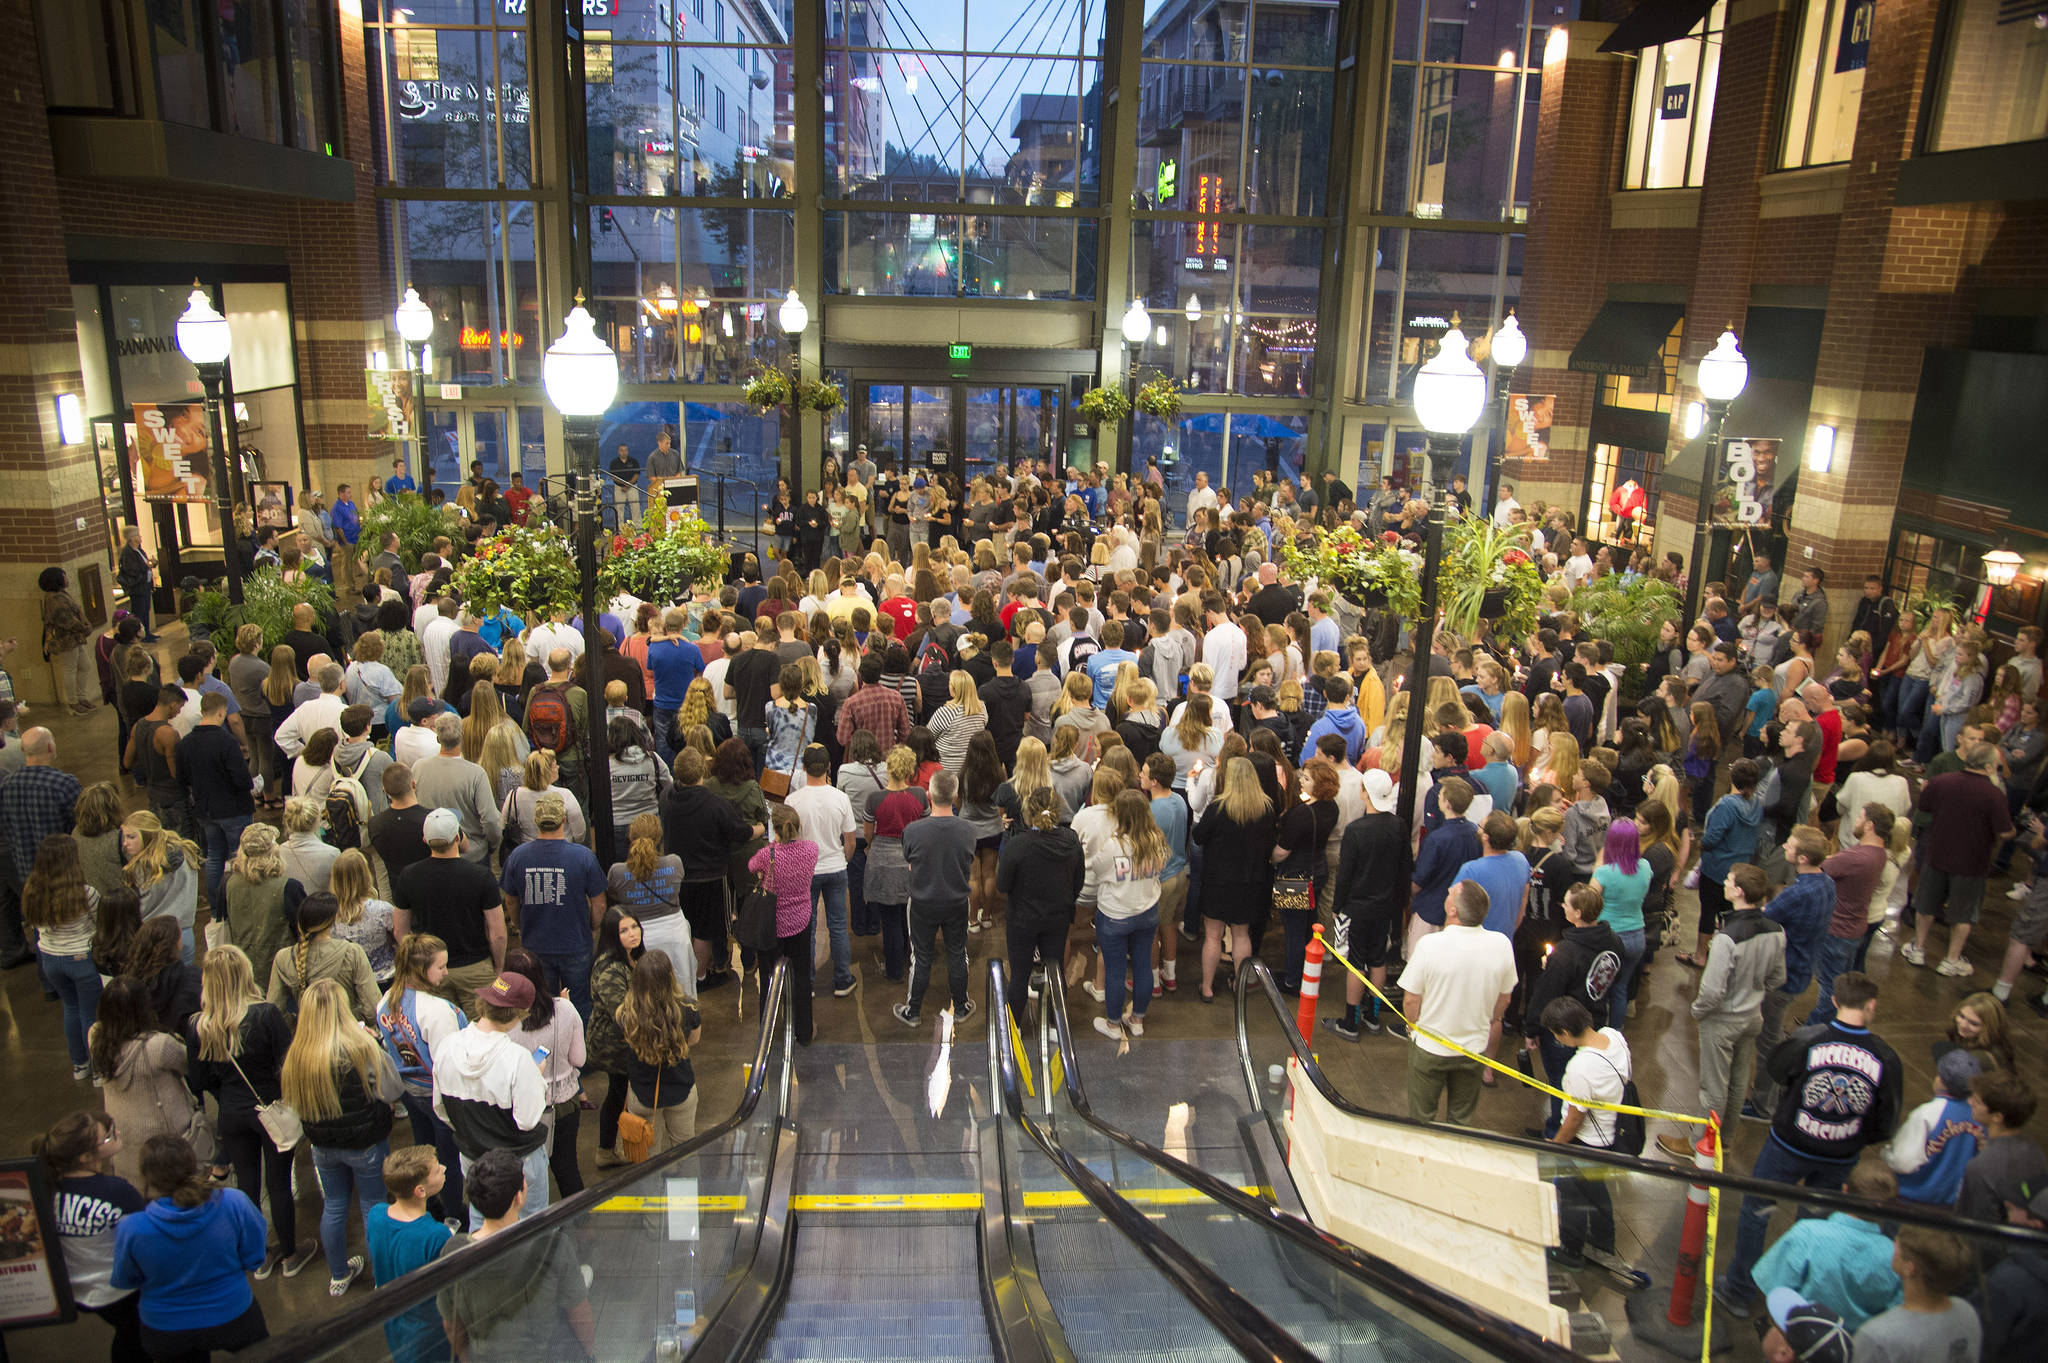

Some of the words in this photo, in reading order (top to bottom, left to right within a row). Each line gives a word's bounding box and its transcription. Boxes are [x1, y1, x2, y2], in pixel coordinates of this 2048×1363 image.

[1851, 3, 1873, 44] GA
[423, 80, 461, 101] The
[1667, 93, 1684, 110] GAP
[117, 335, 167, 357] BANANA
[951, 345, 969, 358] EXIT
[371, 372, 409, 435] FRESH
[1515, 398, 1547, 457] SWEET
[143, 410, 200, 495] SWEET
[1726, 442, 1764, 522] BOLD
[1809, 1043, 1882, 1084] NICKERSON
[1797, 1111, 1861, 1139] RACING
